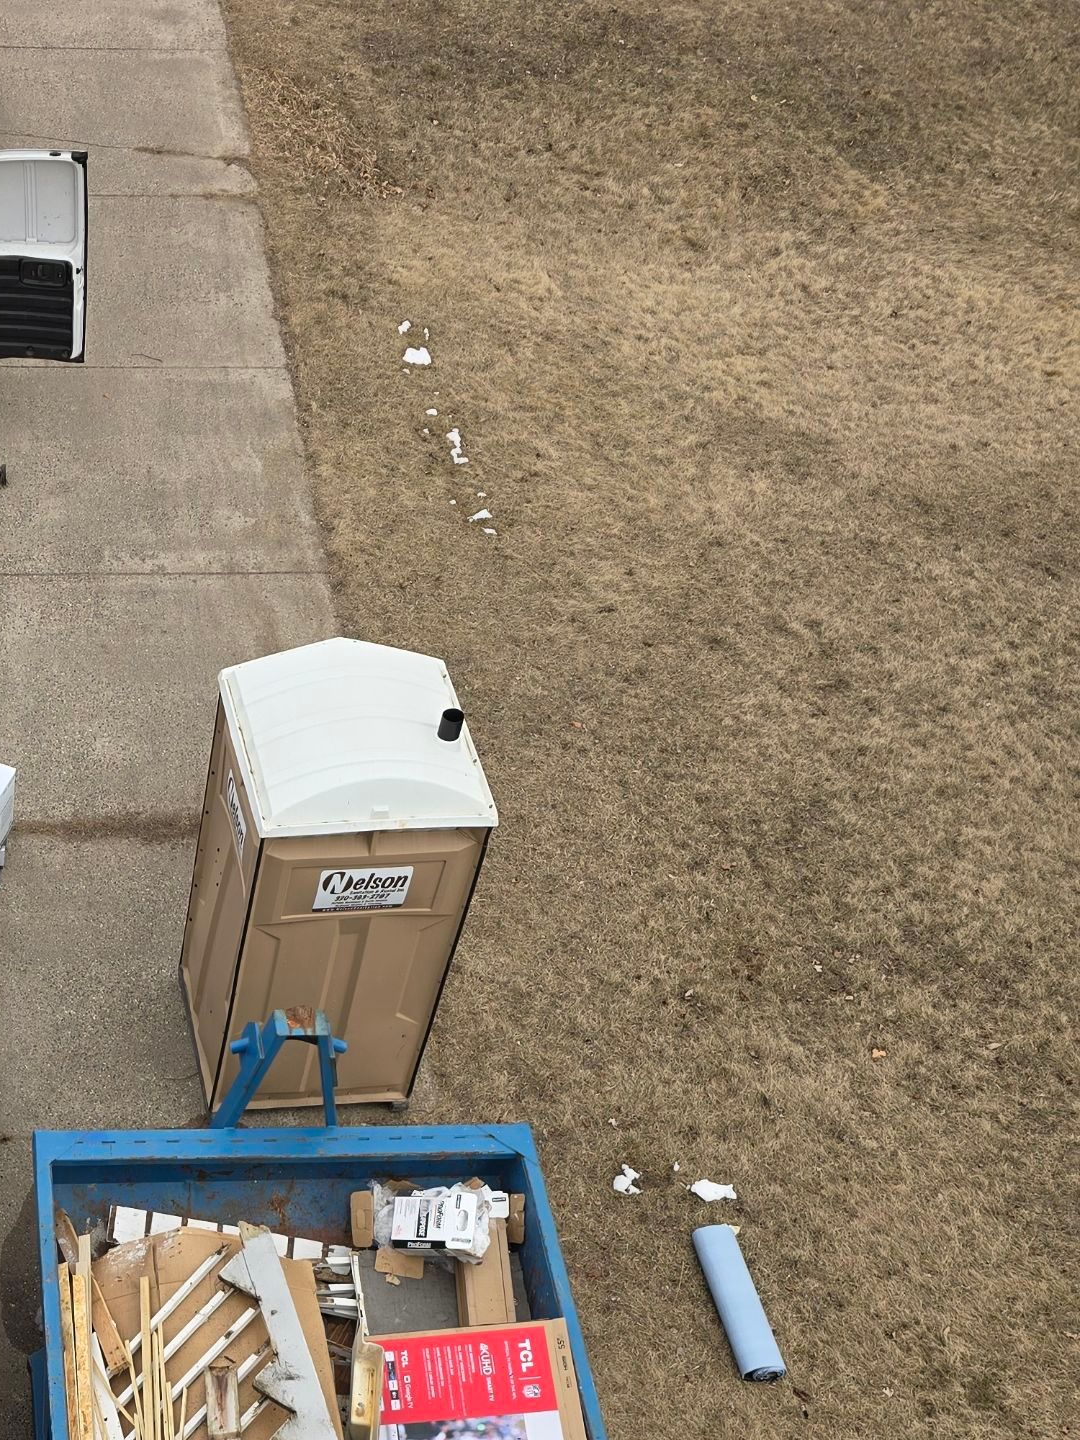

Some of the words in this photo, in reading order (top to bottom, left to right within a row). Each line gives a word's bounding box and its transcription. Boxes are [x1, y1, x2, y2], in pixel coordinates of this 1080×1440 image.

[322, 871, 409, 895] Nelson
[401, 1350, 409, 1368] TCL
[518, 1339, 534, 1373] TCL
